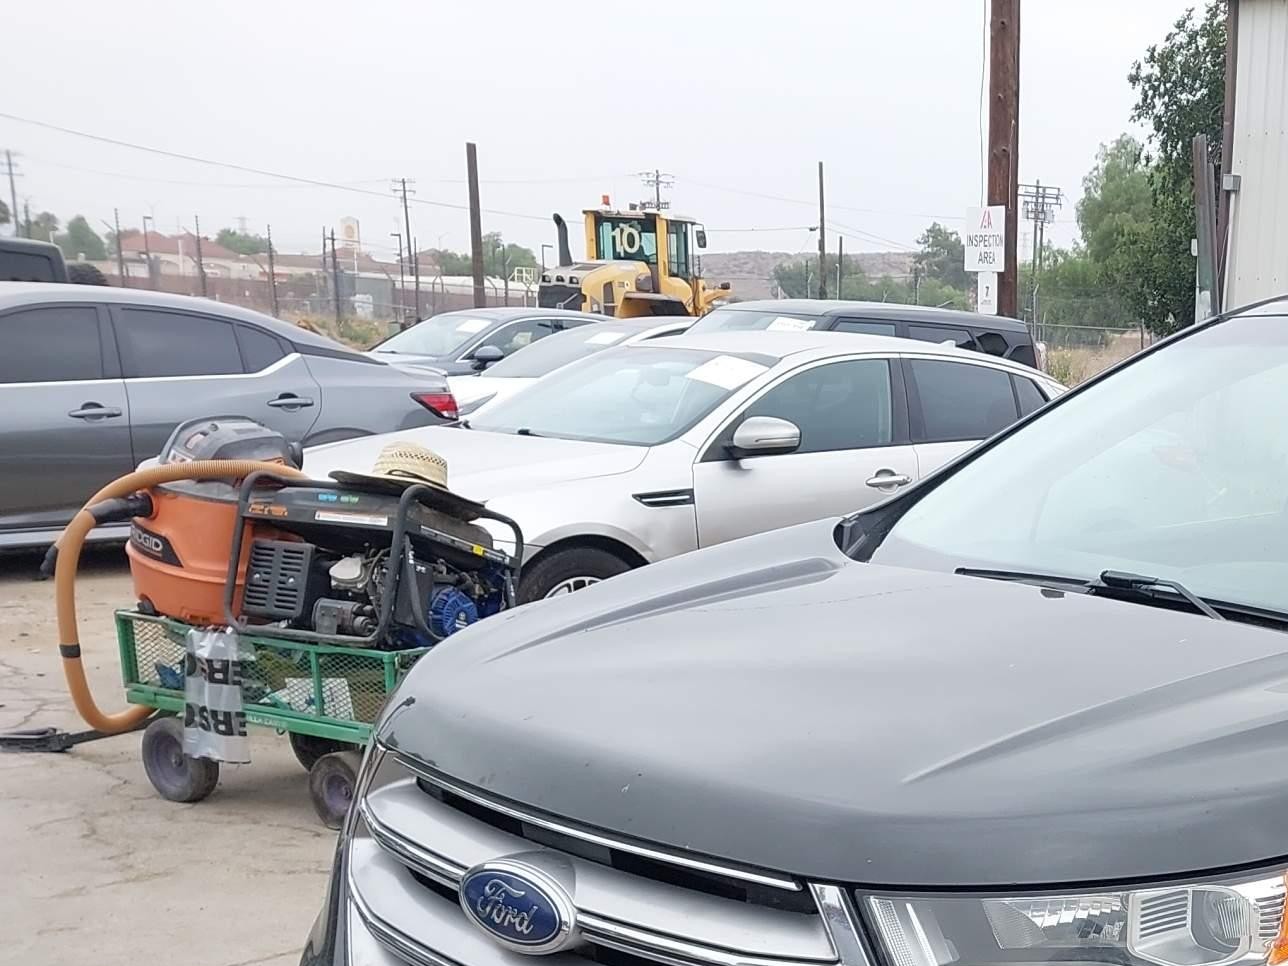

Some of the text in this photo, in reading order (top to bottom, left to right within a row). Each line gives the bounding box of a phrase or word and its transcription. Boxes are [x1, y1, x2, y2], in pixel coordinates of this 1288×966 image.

[611, 223, 640, 257] 10
[966, 234, 1003, 248] INSPECTION
[978, 251, 996, 264] AREA
[476, 878, 539, 935] Ford
